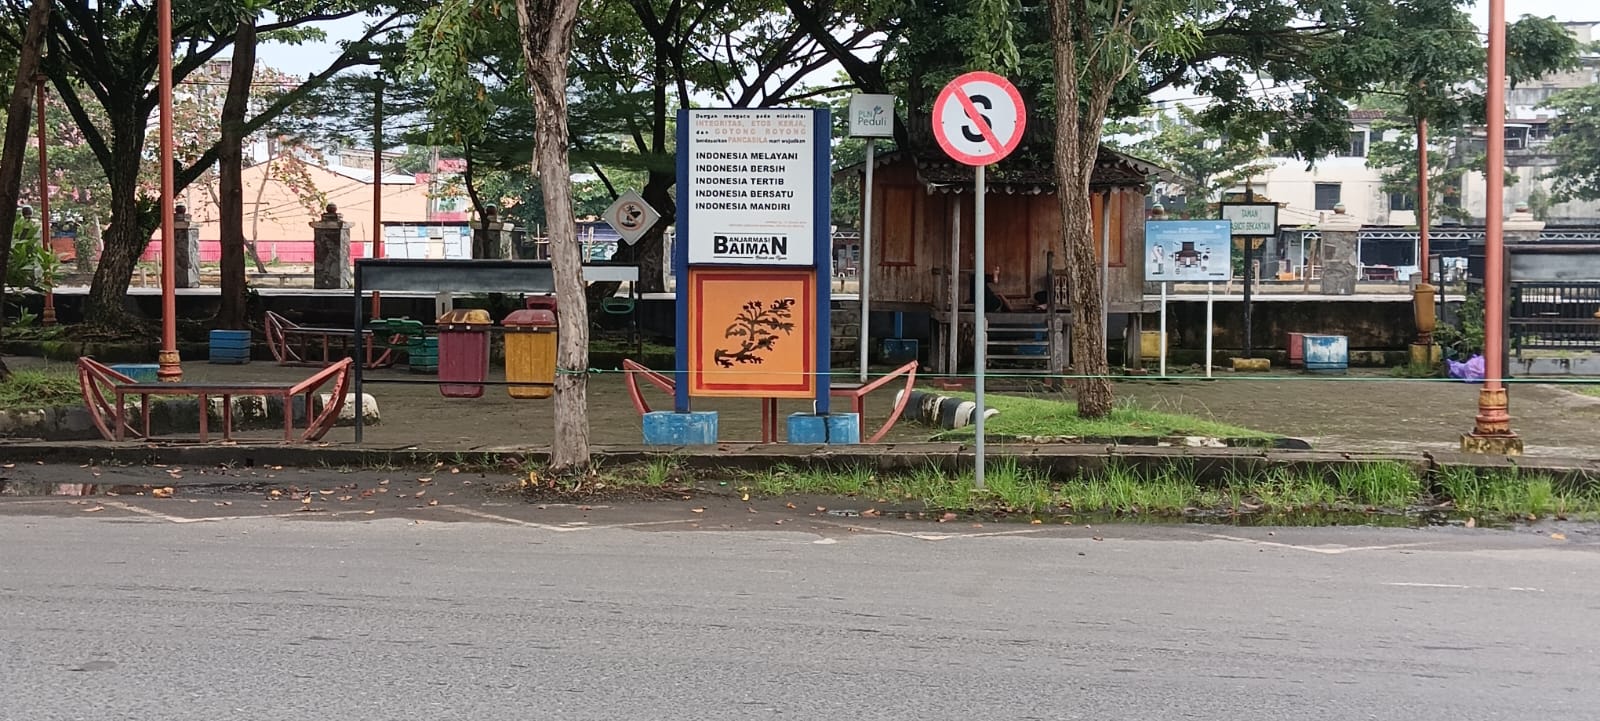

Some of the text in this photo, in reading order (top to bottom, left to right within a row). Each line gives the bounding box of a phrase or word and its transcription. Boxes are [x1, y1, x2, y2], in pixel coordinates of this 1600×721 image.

[858, 117, 887, 126] Peduli
[961, 94, 993, 143] S
[728, 136, 768, 144] PANCASILA
